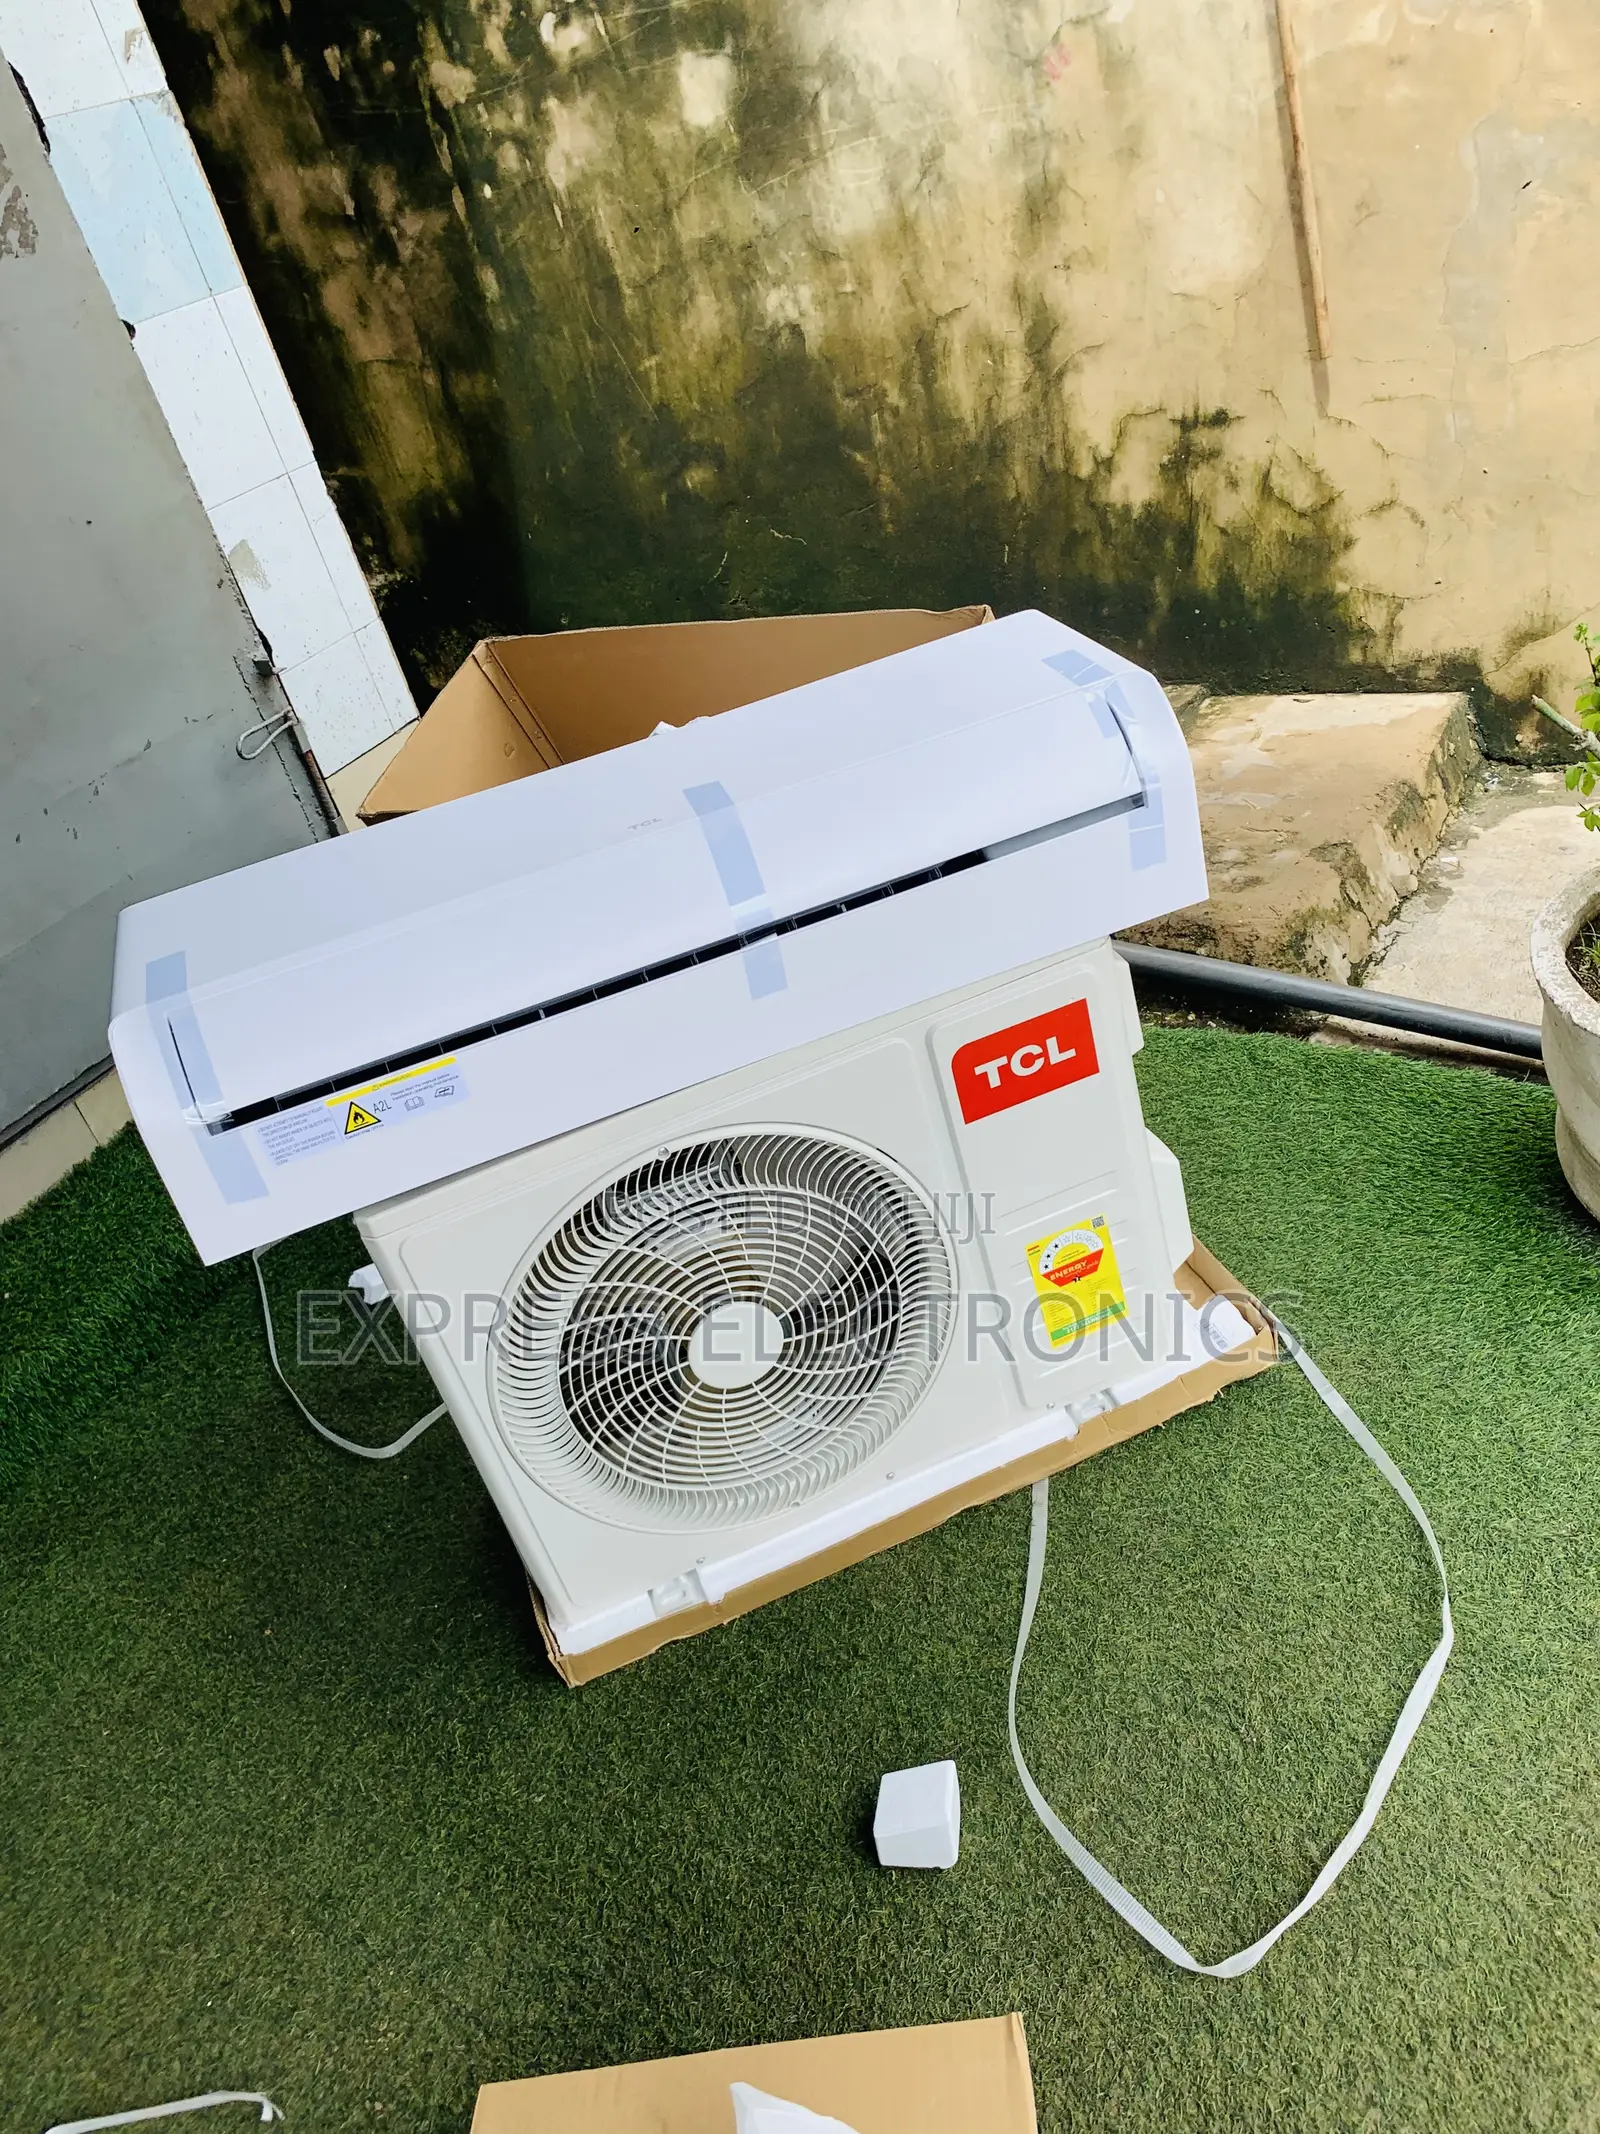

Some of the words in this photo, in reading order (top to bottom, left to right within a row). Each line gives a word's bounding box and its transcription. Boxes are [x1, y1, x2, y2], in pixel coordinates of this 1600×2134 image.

[626, 818, 664, 831] TCL
[974, 1036, 1077, 1089] TCL
[373, 1100, 393, 1114] A2L
[1049, 1260, 1088, 1281] ENERGY
